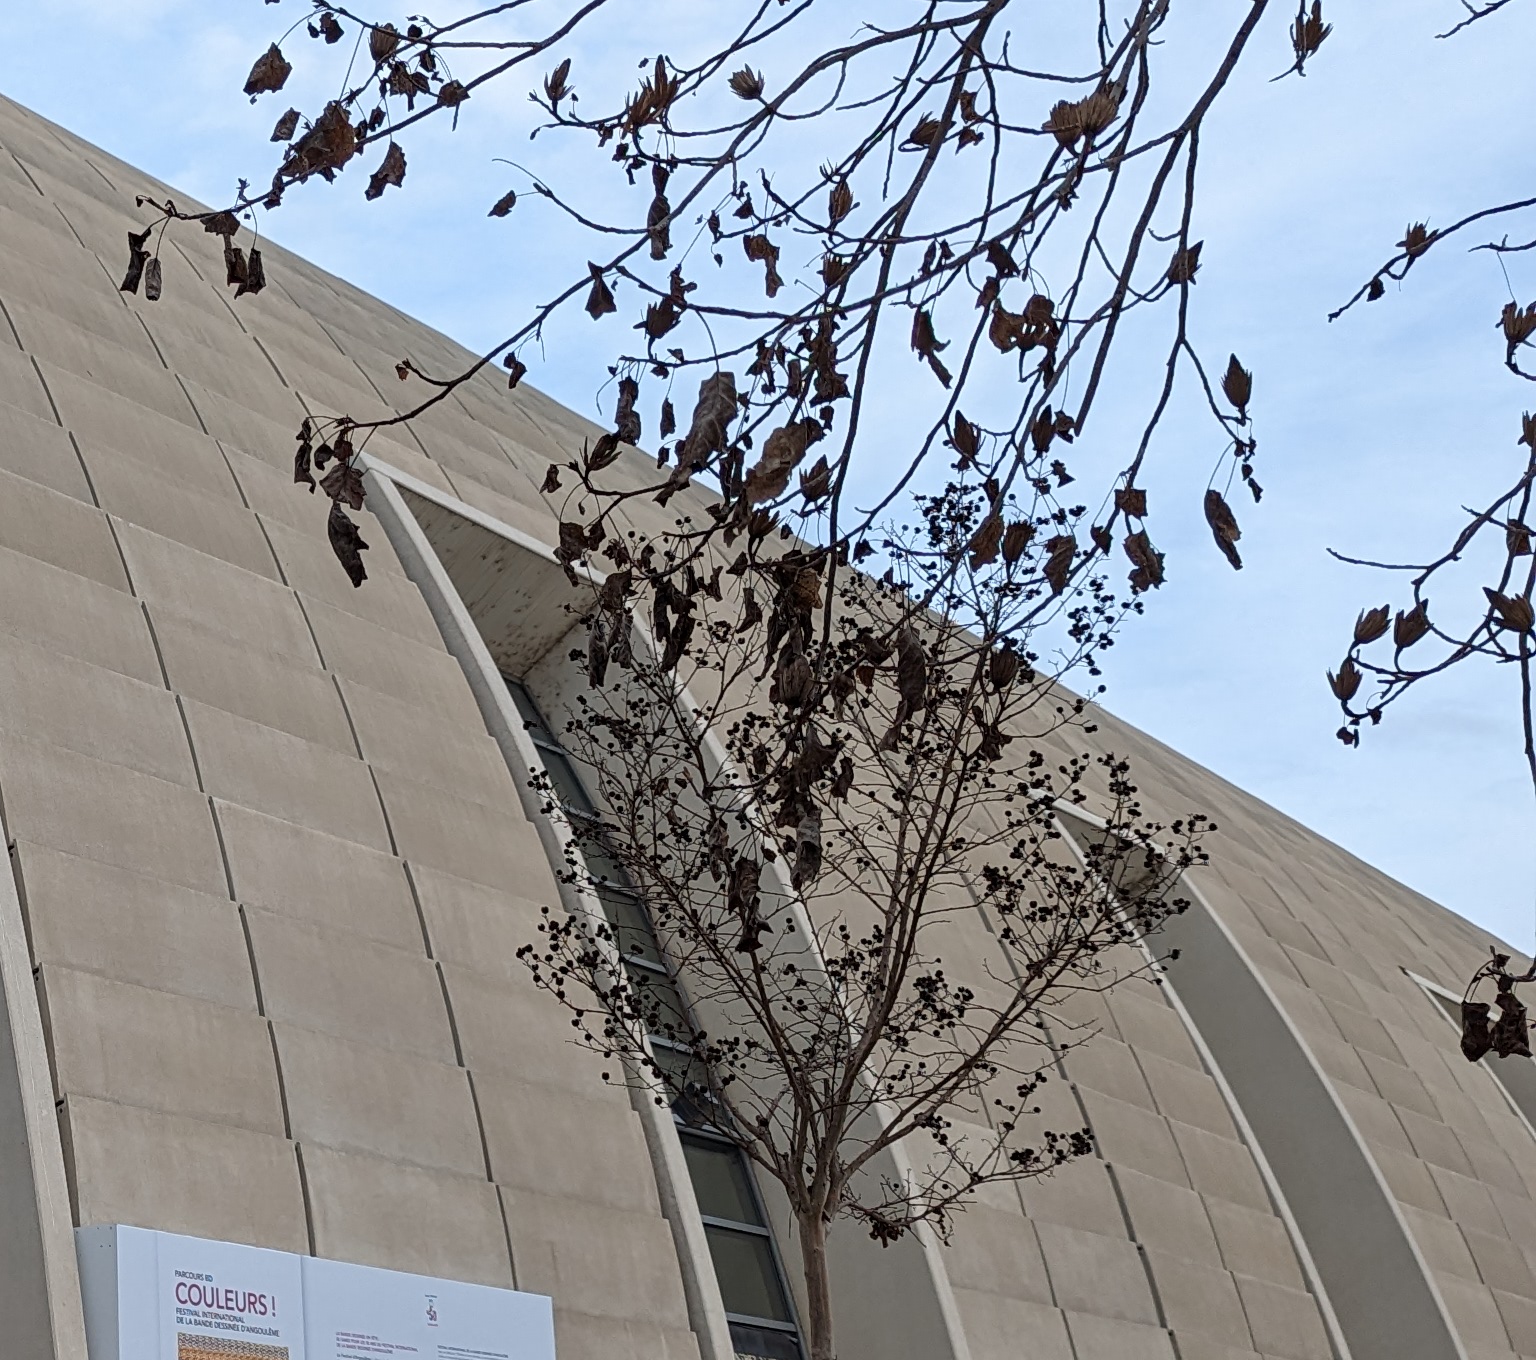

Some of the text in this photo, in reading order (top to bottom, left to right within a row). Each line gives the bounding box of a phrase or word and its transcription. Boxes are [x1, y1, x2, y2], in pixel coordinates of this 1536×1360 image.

[174, 1269, 205, 1282] PARCOURS
[175, 1281, 276, 1318] COULEURS !
[175, 1306, 246, 1324] FESTIVAL INTERNATIONAL
[194, 1319, 213, 1329] BANDE
[214, 1321, 241, 1332] DESSINÉE
